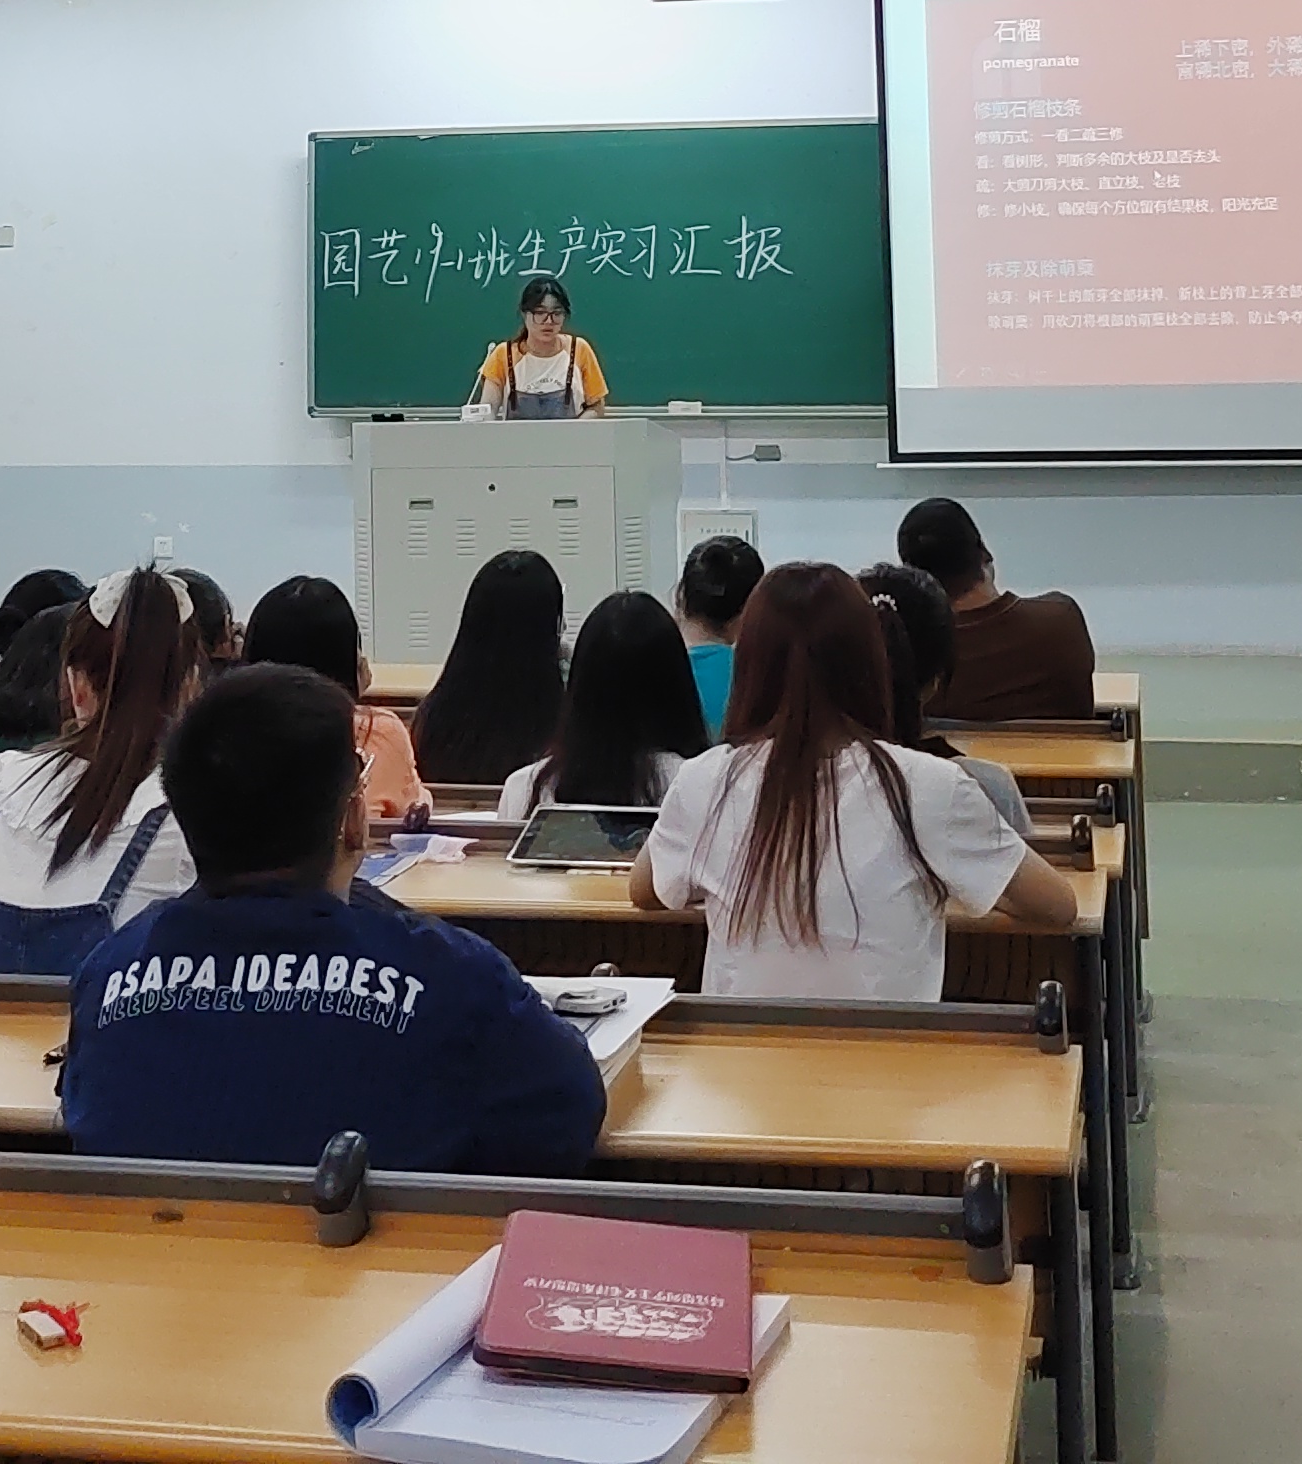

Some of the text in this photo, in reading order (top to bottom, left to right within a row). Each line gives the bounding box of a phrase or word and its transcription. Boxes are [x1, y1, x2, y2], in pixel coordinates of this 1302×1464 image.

[993, 18, 1041, 43] 石榴
[983, 54, 1080, 73] pomegranate
[973, 97, 1084, 120] 修剪石榴枝条
[102, 953, 425, 1014] BSAPA IDEABEST
